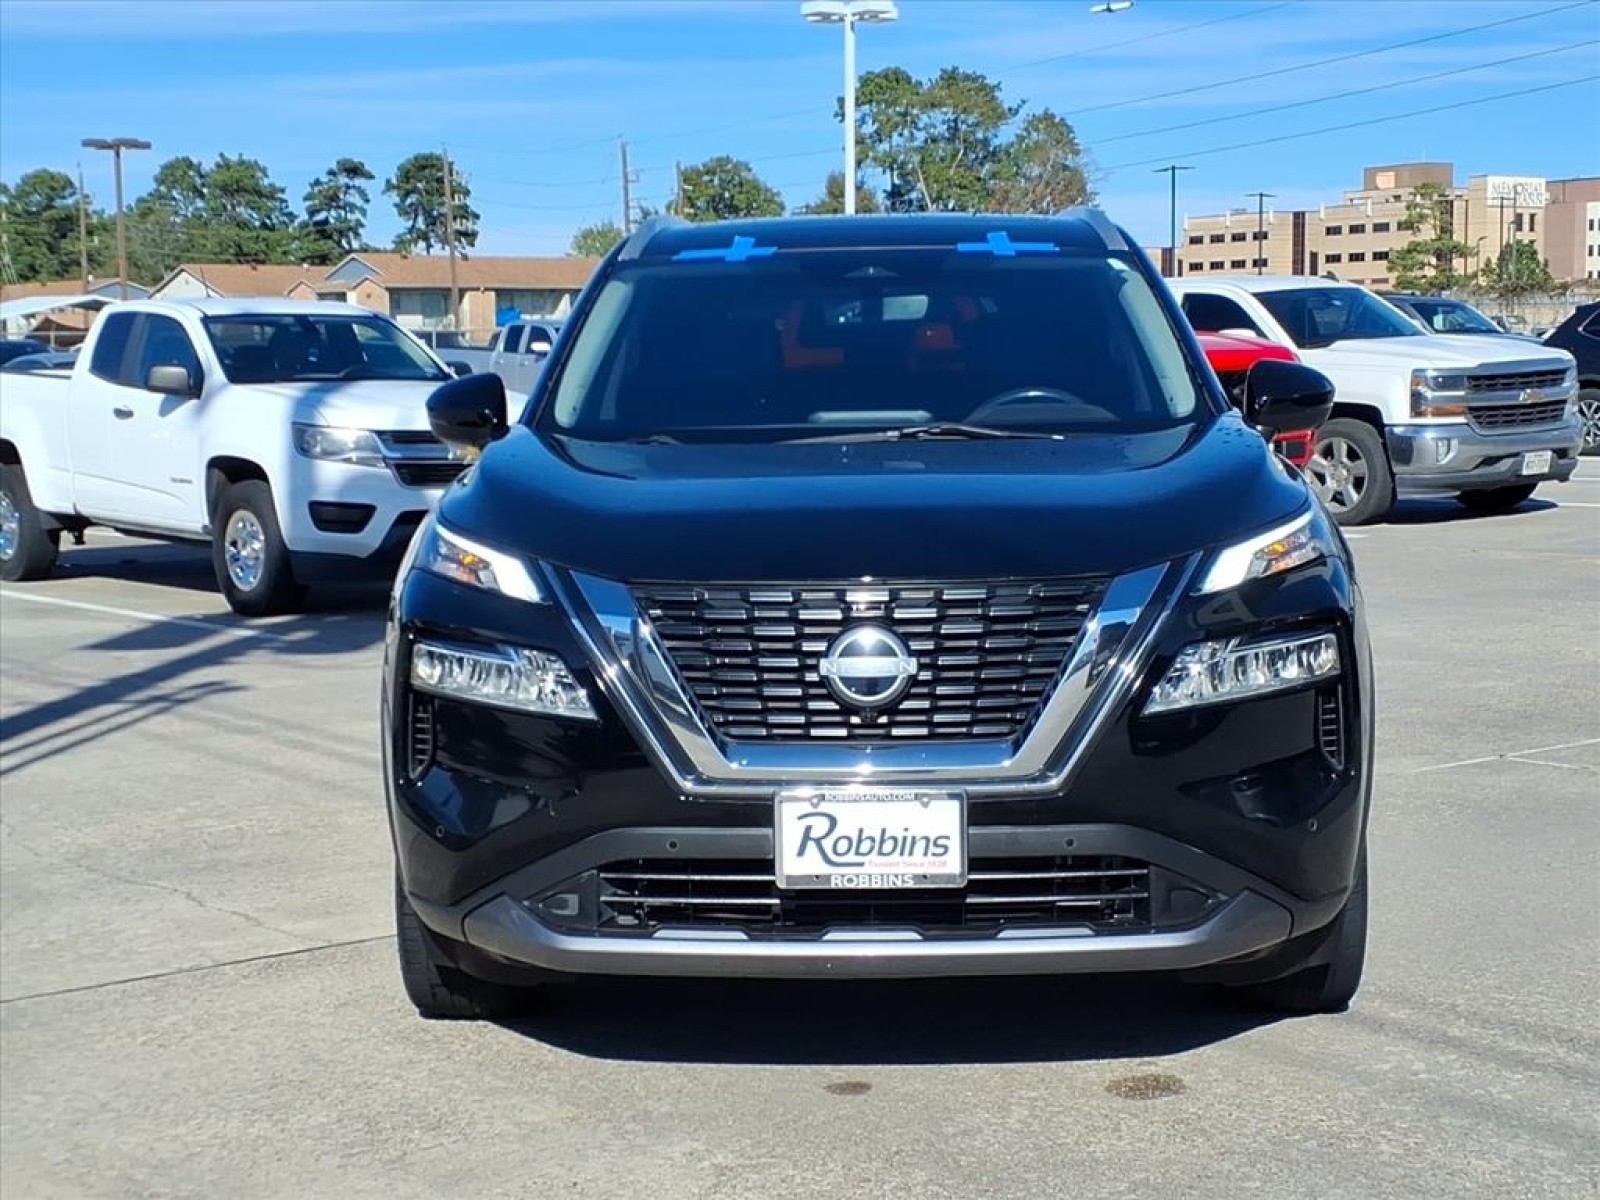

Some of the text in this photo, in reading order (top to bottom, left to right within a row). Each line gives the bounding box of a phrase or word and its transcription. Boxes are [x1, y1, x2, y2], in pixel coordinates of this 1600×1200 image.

[822, 660, 916, 675] NIN
[796, 811, 951, 868] Robbins
[830, 874, 914, 888] ROBBINS
